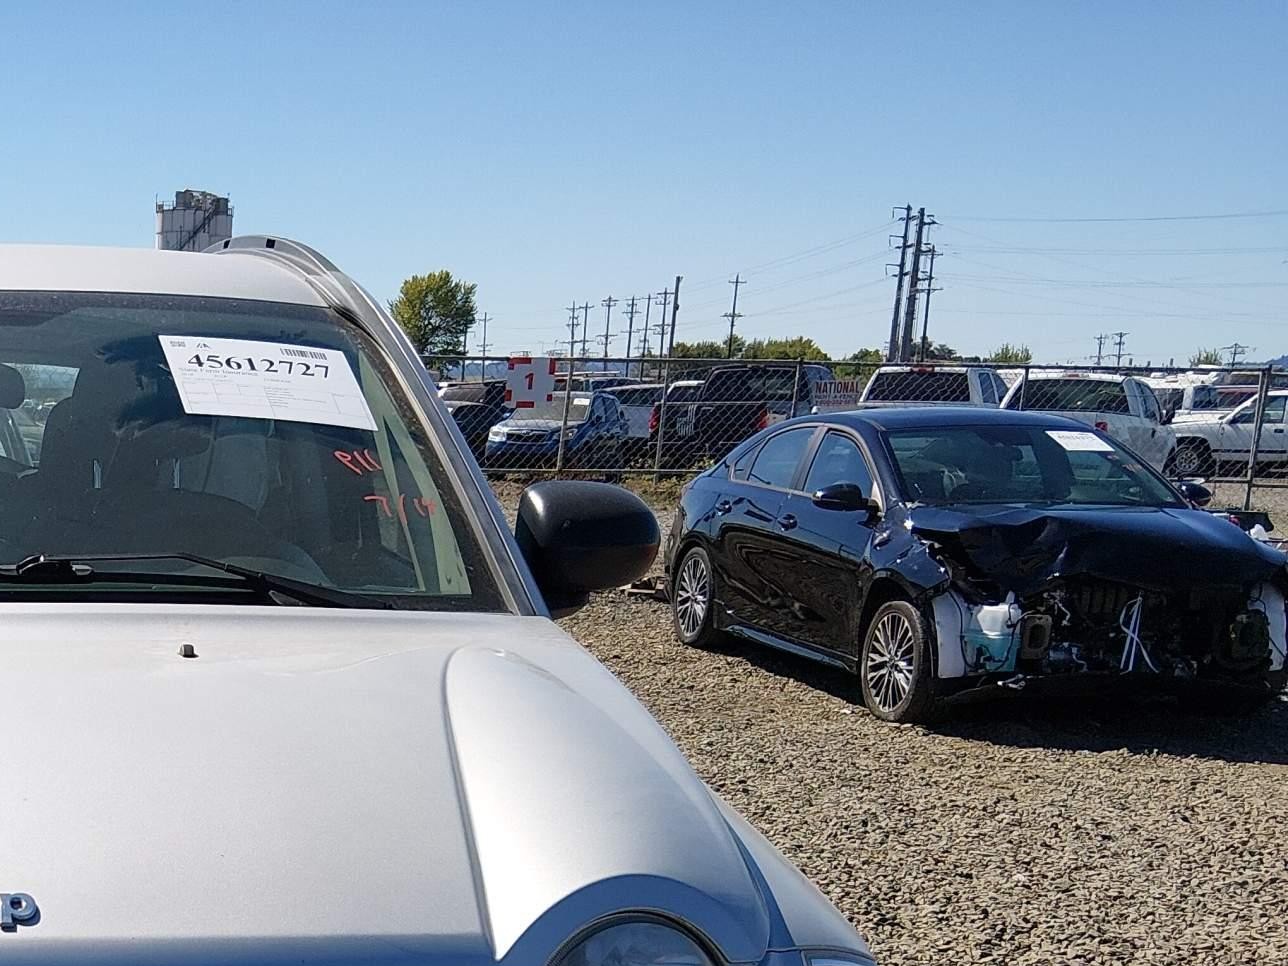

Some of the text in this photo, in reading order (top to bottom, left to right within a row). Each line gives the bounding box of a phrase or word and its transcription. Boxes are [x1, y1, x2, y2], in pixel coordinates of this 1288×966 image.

[187, 354, 329, 378] 45612727
[524, 372, 534, 390] 1
[815, 381, 859, 394] NATIONAL
